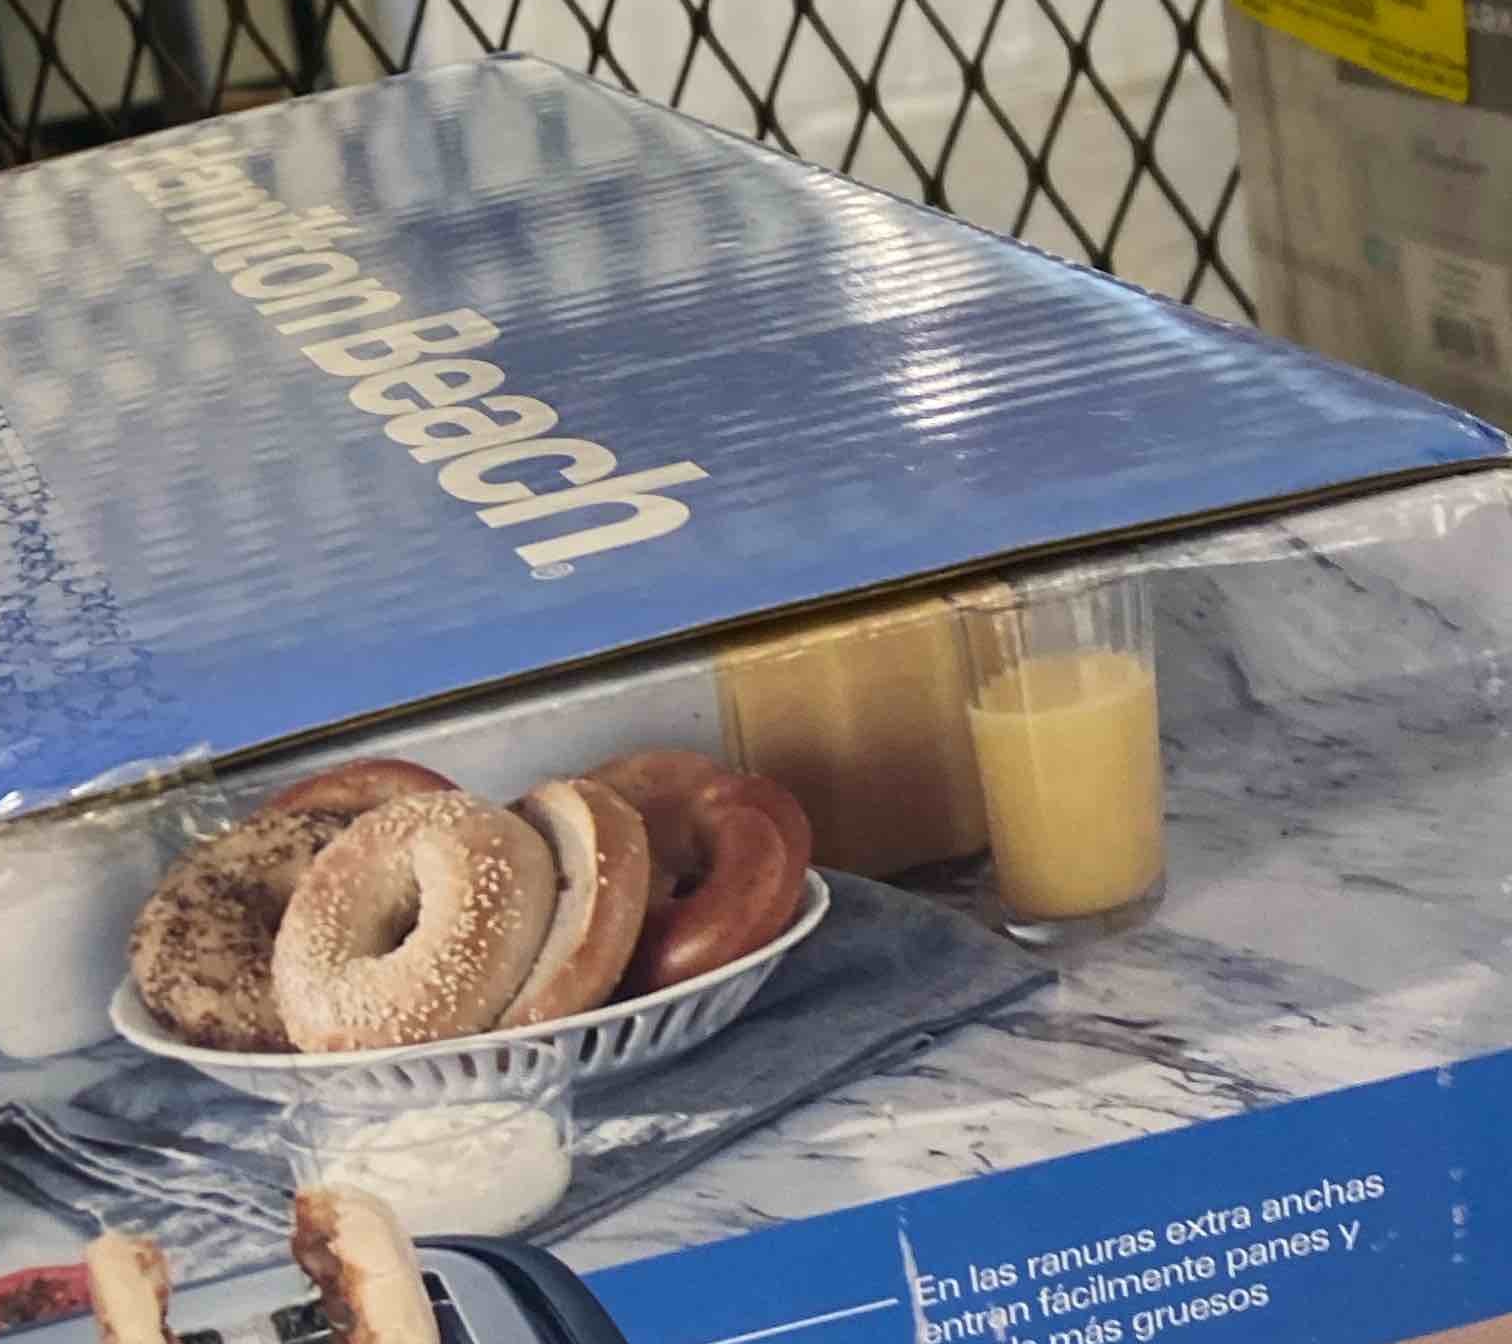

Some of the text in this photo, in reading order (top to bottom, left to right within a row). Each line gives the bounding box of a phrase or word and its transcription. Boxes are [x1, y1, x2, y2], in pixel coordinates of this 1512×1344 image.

[300, 307, 711, 569] Beach
[916, 1172, 1385, 1308] En las ranuras extra anchas
[1038, 1258, 1216, 1317] fácilmente
[1226, 1226, 1330, 1275] panes
[1338, 1220, 1360, 1252] y
[1133, 1281, 1270, 1342] gruesos
